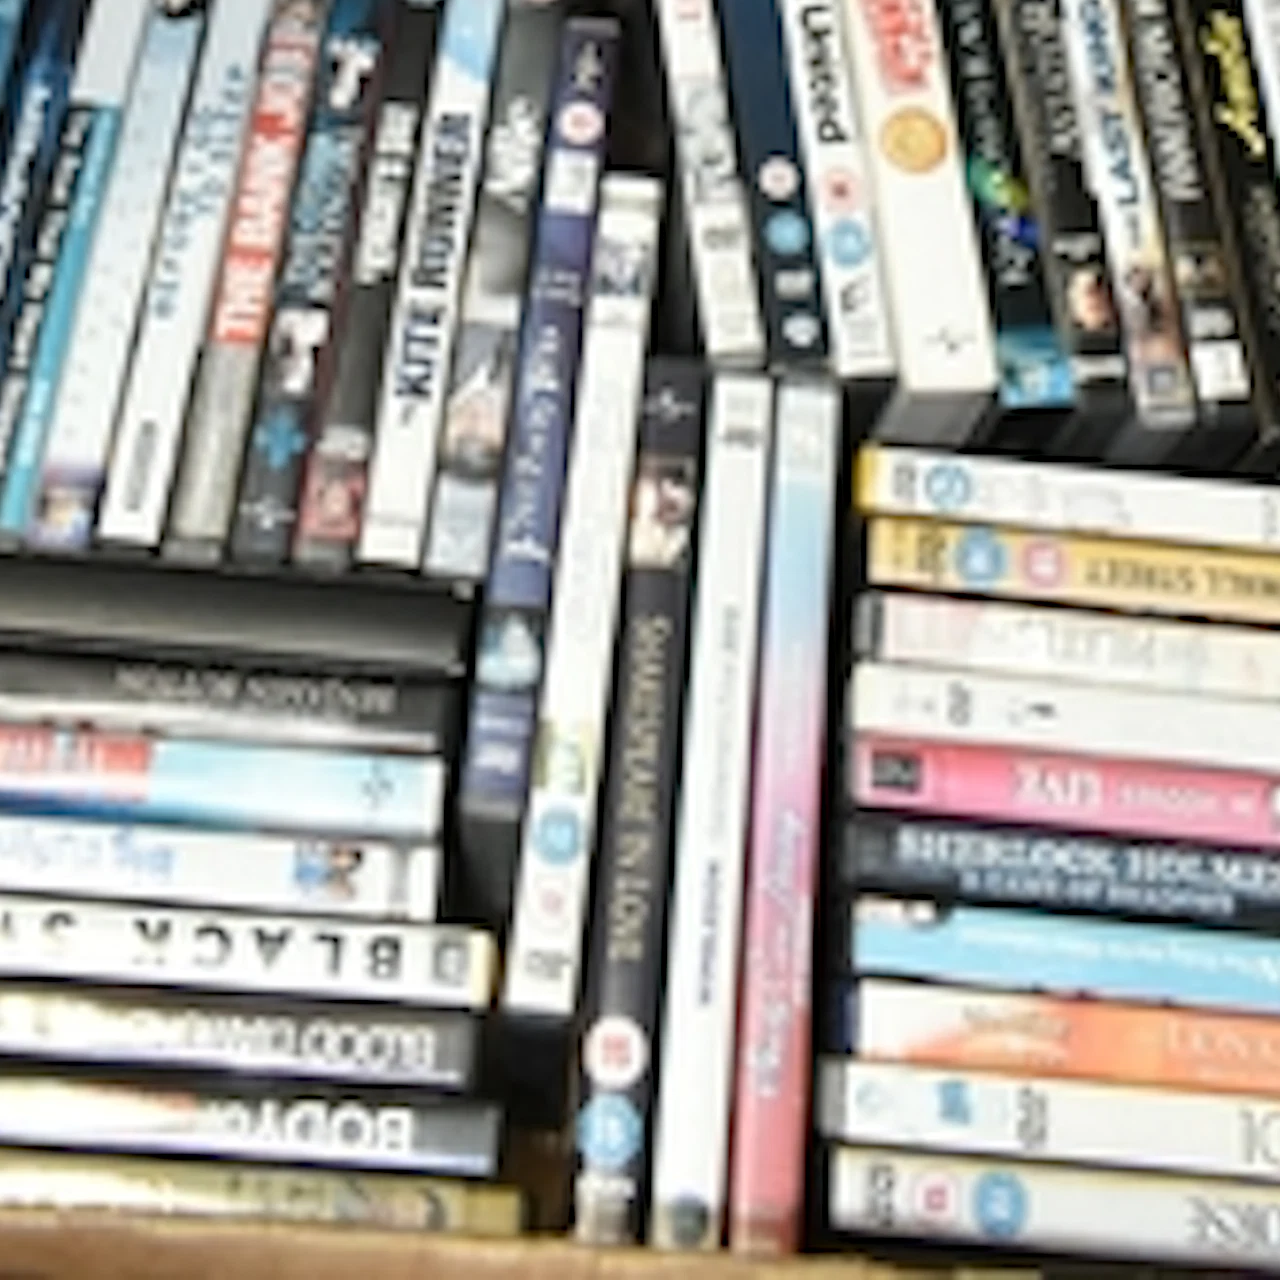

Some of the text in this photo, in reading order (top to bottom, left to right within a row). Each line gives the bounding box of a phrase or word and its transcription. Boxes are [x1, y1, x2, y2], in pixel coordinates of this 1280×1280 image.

[799, 6, 848, 144] United
[229, 130, 296, 249] BANK
[411, 109, 471, 290] RUNNER
[210, 252, 271, 340] THE
[395, 303, 442, 400] KITE
[1084, 561, 1199, 597] STREET
[114, 662, 398, 716] BENJAMIN BUTTON
[620, 616, 673, 821] SHAKESPEARE
[131, 917, 404, 981] BLACK
[608, 877, 651, 962] LOVE
